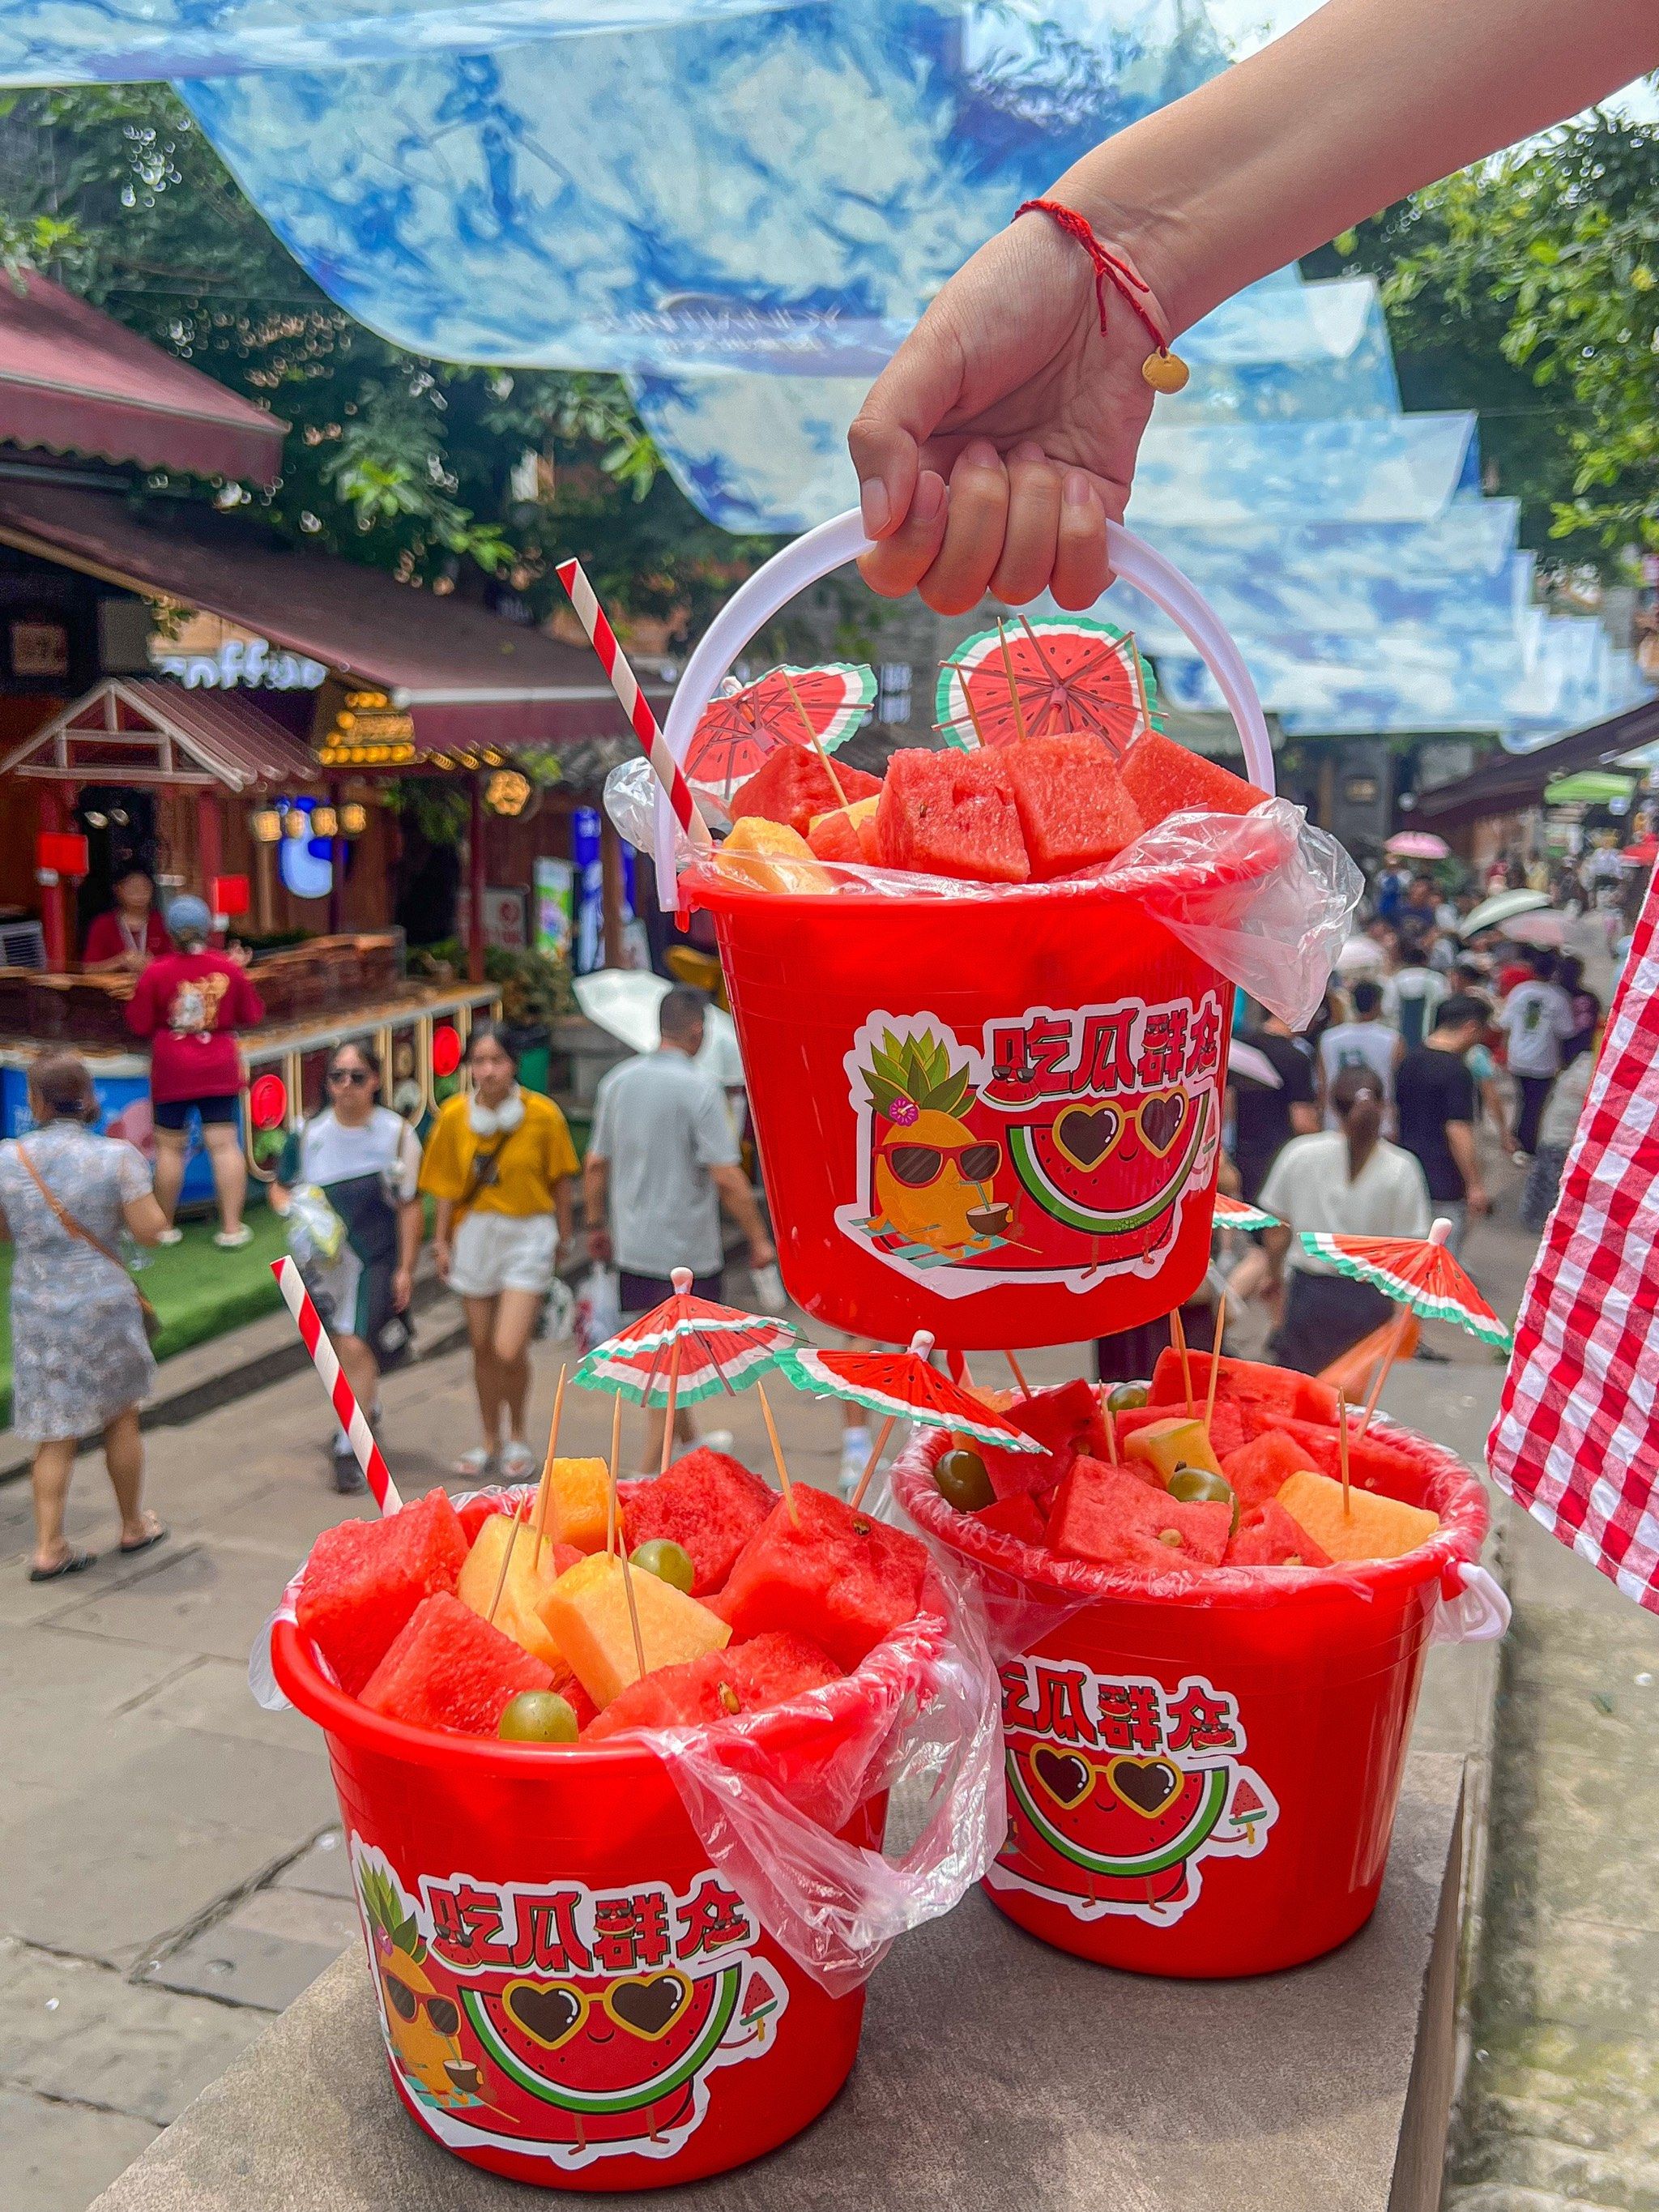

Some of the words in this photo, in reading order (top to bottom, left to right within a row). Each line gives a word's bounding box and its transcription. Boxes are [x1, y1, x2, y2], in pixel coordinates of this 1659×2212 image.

[985, 1001, 1220, 1104] 吃瓜群众
[428, 1879, 750, 1972] 吃瓜群众
